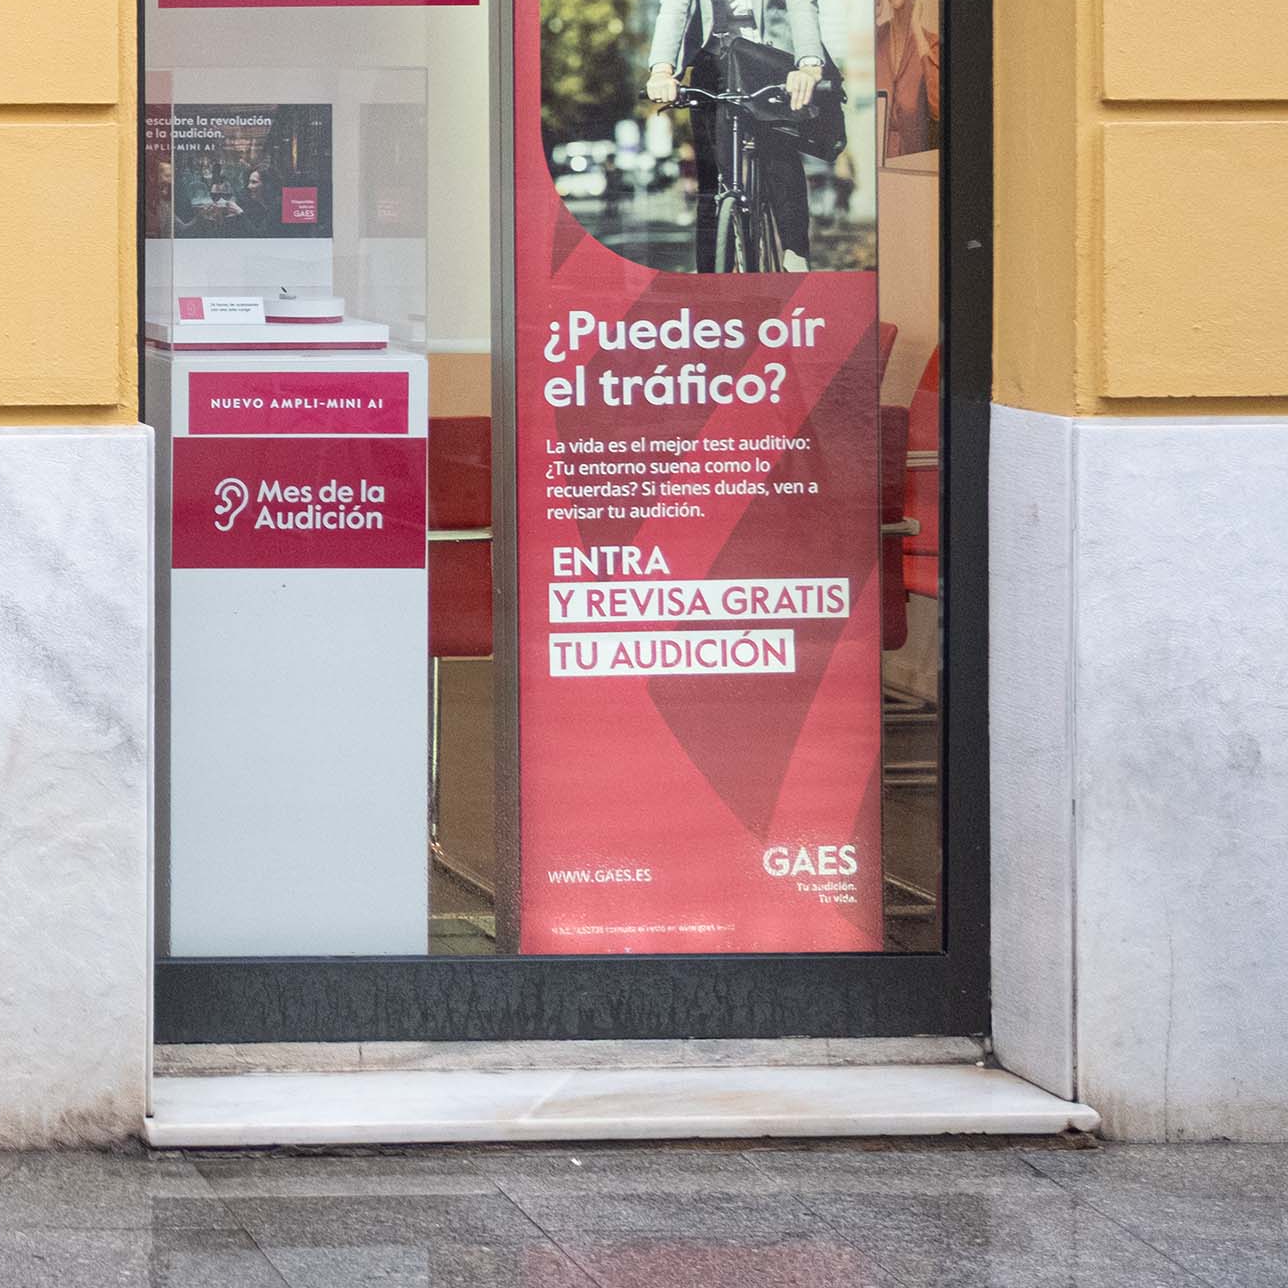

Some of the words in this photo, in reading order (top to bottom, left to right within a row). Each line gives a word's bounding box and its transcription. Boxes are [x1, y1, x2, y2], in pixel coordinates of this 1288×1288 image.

[145, 115, 193, 126] escubre
[197, 115, 207, 125] la
[210, 115, 271, 126] revolución
[146, 128, 152, 138] e
[156, 128, 166, 138] la
[171, 127, 225, 138] audición.
[544, 308, 745, 363] ¿Puedes
[757, 307, 826, 349] oír
[544, 365, 585, 406] el
[599, 362, 786, 406] tráfico?
[211, 398, 264, 409] NUEVO
[270, 398, 362, 409] AMPLI-MINI
[368, 398, 383, 409] AI
[546, 439, 566, 455] La
[569, 438, 604, 454] vida
[608, 441, 627, 454] es
[630, 437, 646, 453] el
[649, 437, 699, 456] mejor
[703, 437, 735, 452] test
[738, 435, 811, 451] auditivo:
[545, 461, 575, 479] ¿Tu
[579, 461, 646, 476] entorno
[649, 462, 701, 475] suena
[705, 460, 751, 474] como
[754, 458, 771, 473] lo
[257, 480, 312, 503] Mes
[319, 479, 354, 503] de
[361, 479, 385, 503] la
[546, 482, 637, 498] recuerdas?
[641, 482, 656, 497] Si
[659, 480, 711, 496] tienes
[714, 479, 770, 498] dudas,
[774, 482, 804, 495] ven
[807, 482, 818, 494] a
[254, 505, 383, 529] Audición
[546, 504, 604, 520] revisar
[607, 505, 626, 519] tu
[629, 501, 705, 519] audición.
[552, 546, 670, 577] ENTRA
[553, 590, 576, 618] Y
[586, 587, 711, 617] REVISA
[722, 584, 845, 615] GRATIS
[553, 640, 598, 671] TU
[610, 630, 787, 669] AUDICIÓN
[763, 844, 858, 878] GAES
[547, 868, 652, 884] WWW.GAES.ES
[796, 882, 809, 892] Tu
[811, 881, 857, 891] audición.
[818, 894, 831, 903] Tu
[832, 894, 857, 903] vida.
